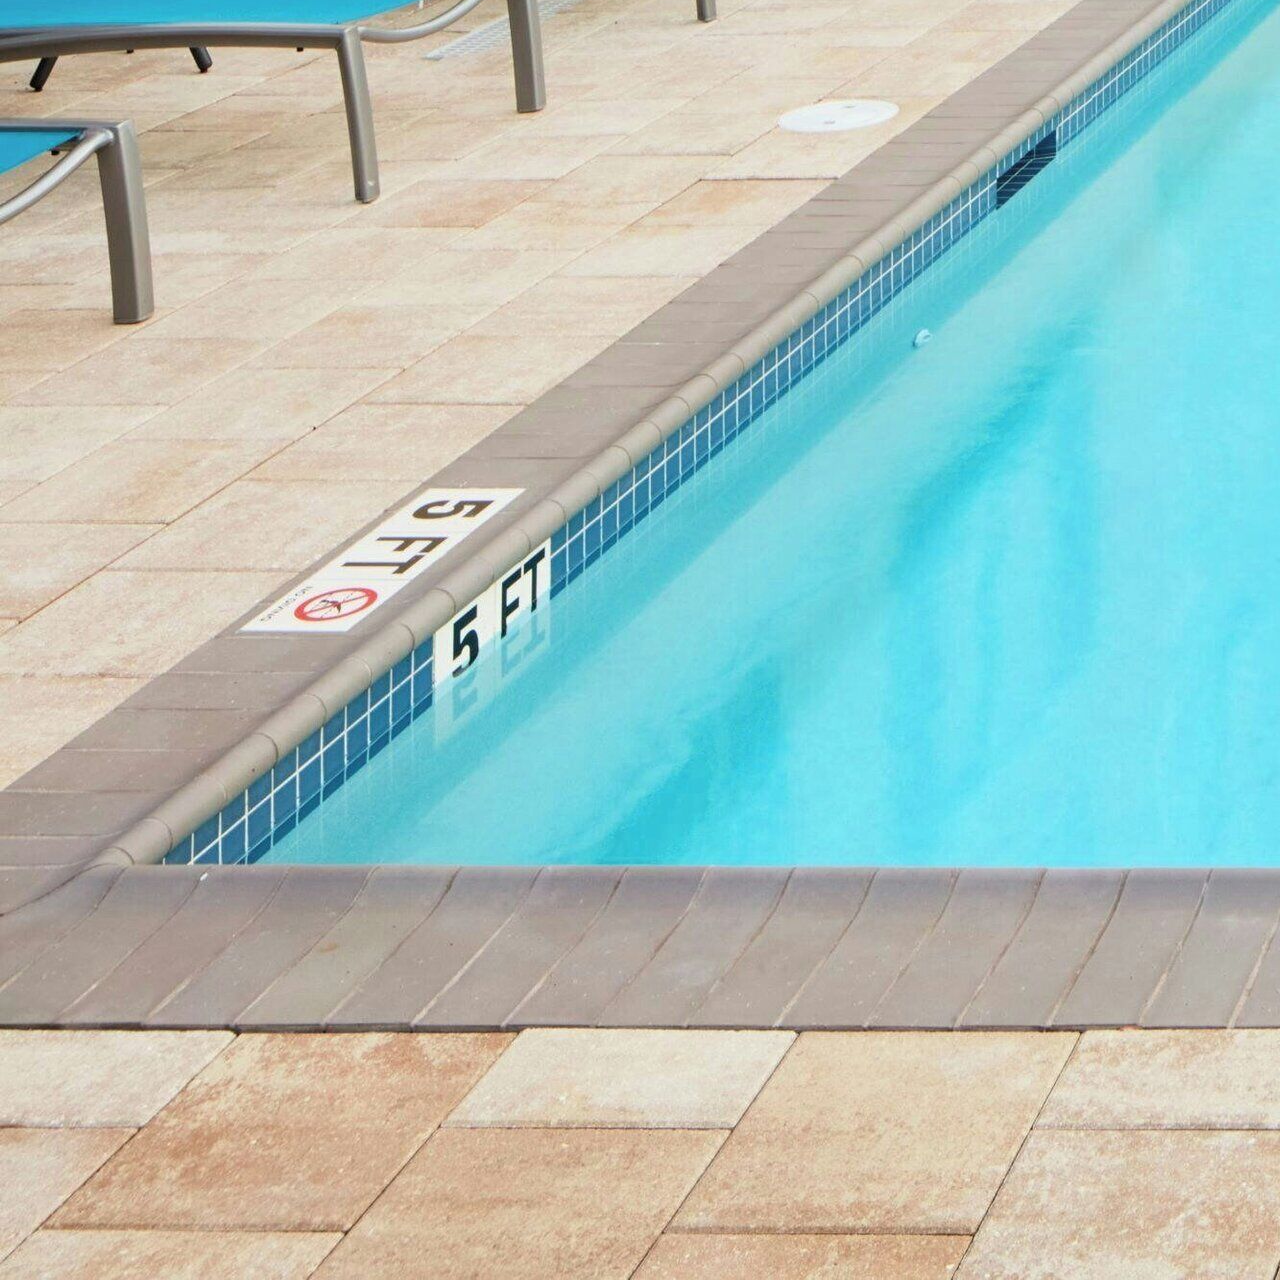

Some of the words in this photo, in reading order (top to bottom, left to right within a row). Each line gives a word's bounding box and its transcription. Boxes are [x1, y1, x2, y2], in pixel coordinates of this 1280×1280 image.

[412, 499, 494, 520] 5
[341, 536, 449, 574] FT
[452, 604, 479, 677] 5
[500, 547, 546, 638] FT
